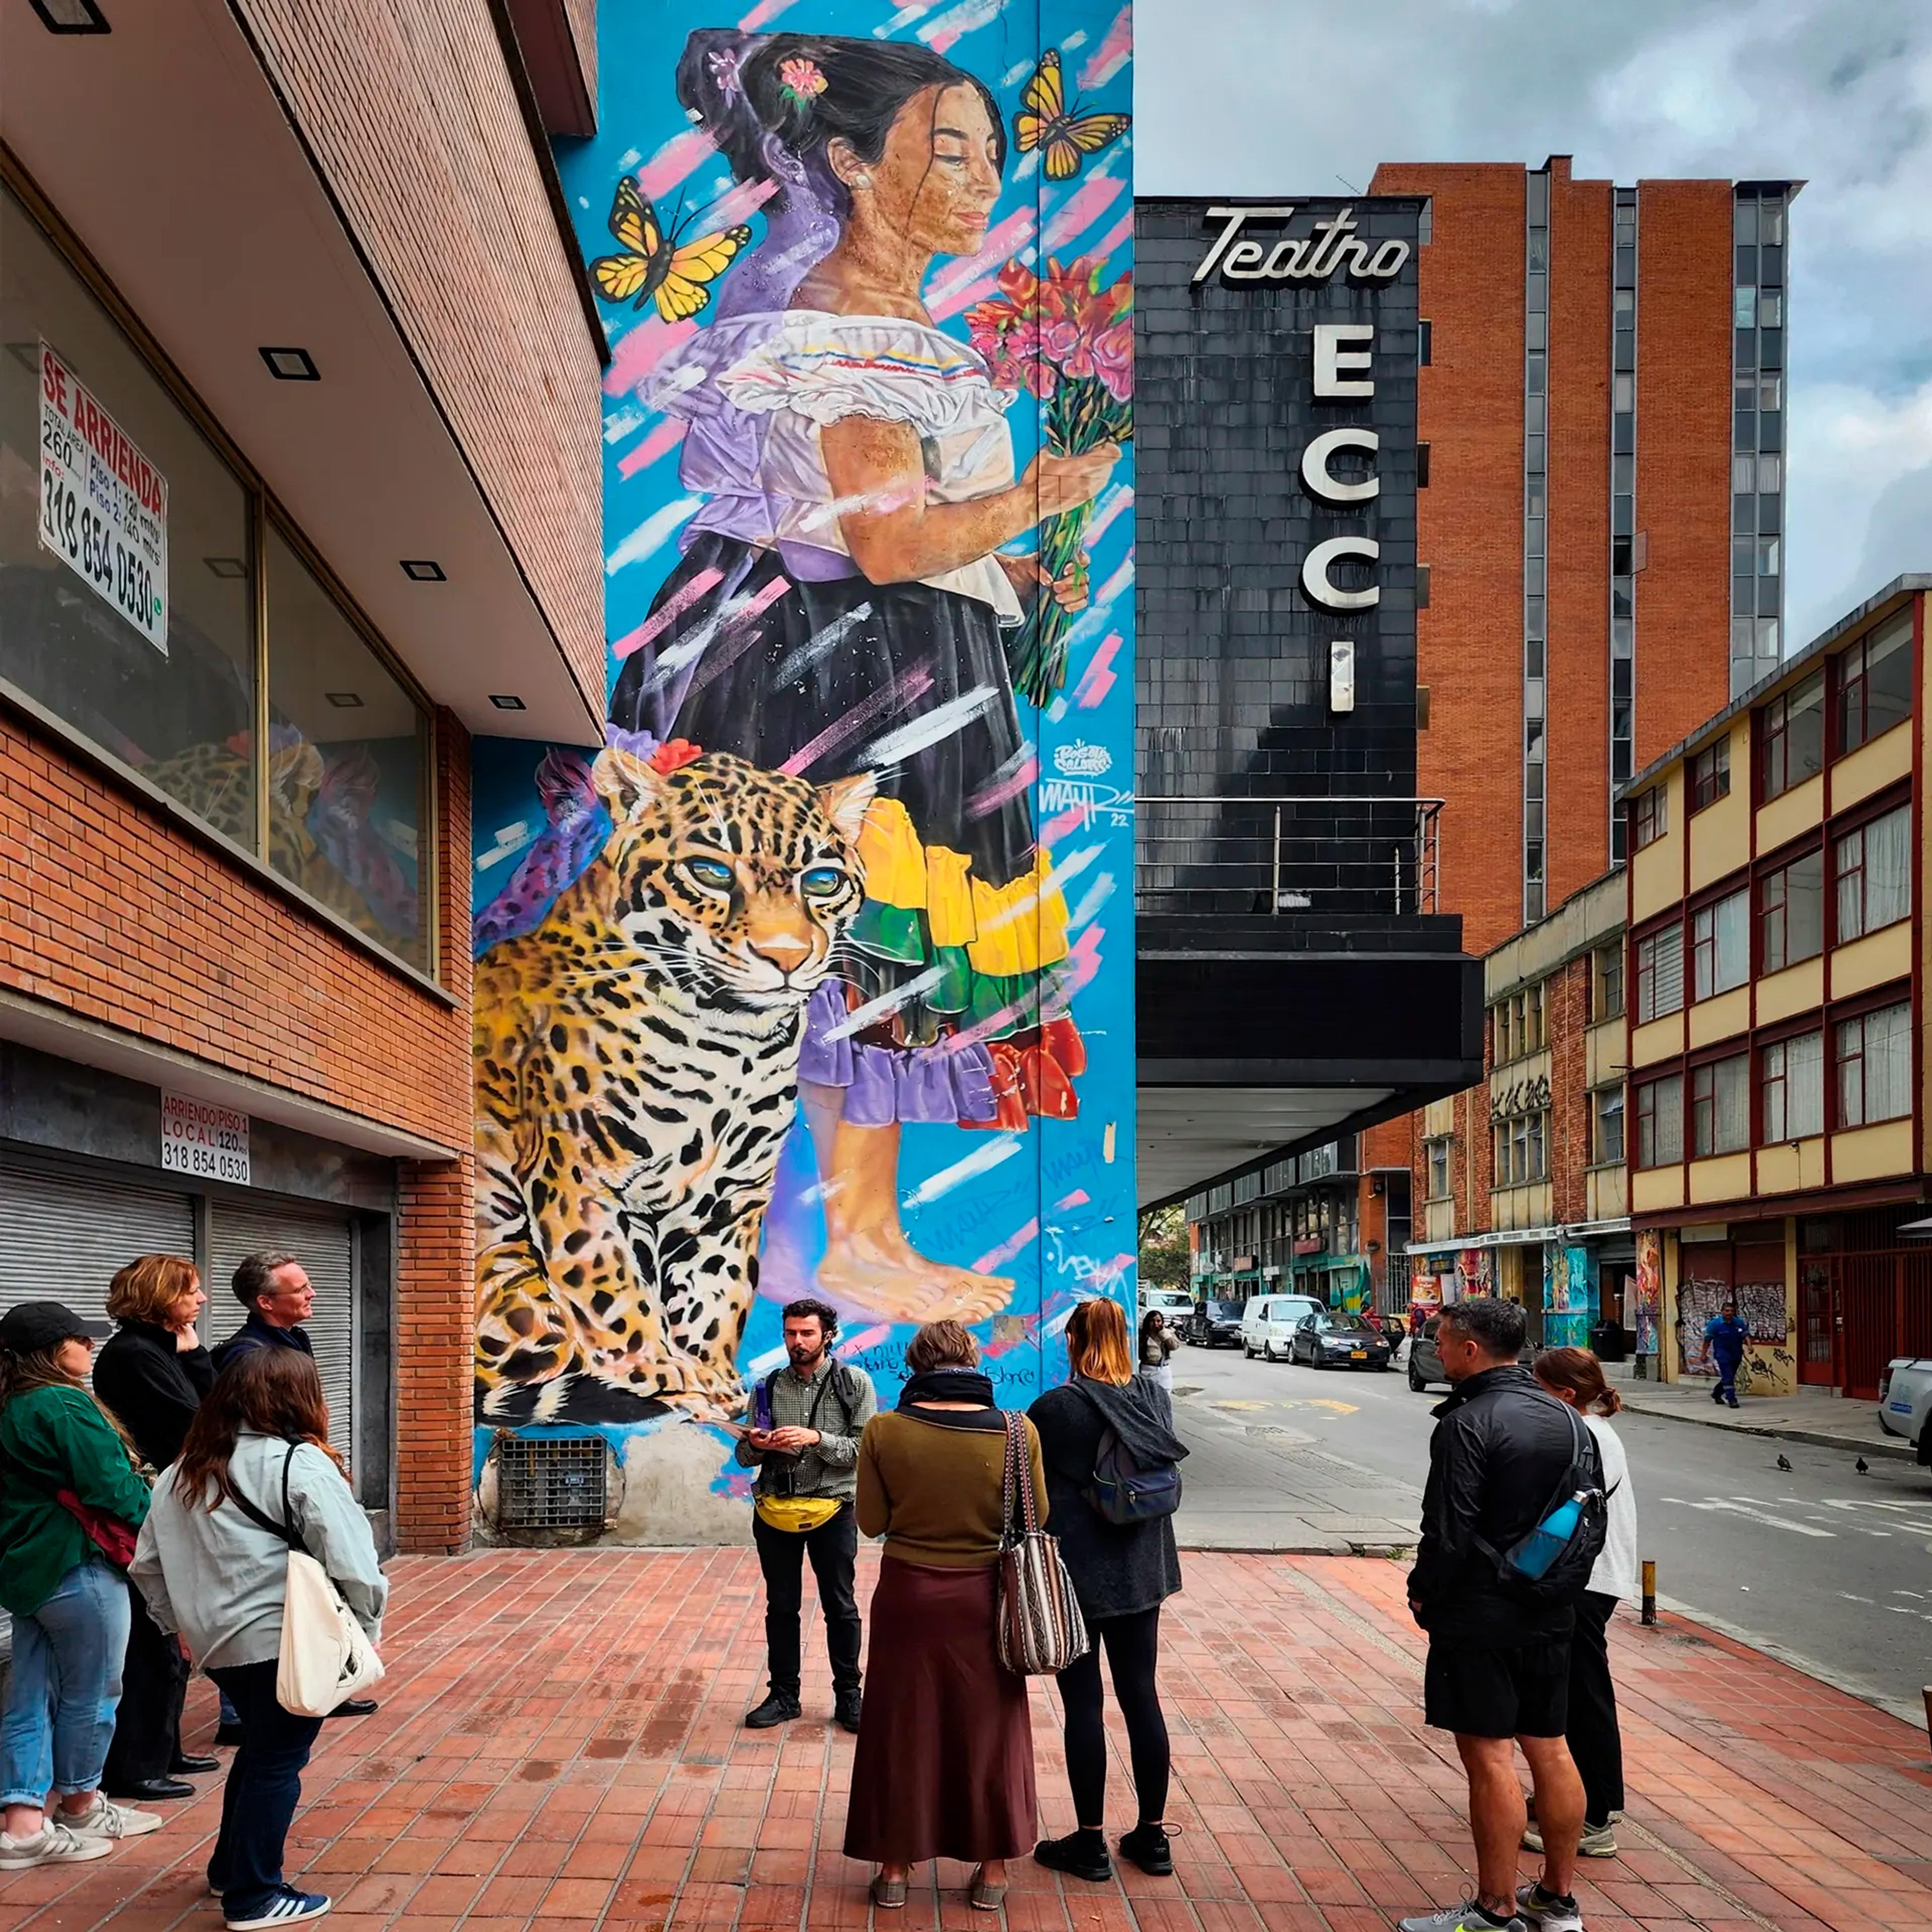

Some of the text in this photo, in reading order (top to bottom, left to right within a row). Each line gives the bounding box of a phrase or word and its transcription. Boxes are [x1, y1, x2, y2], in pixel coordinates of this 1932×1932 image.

[1191, 206, 1411, 282] Teatro
[43, 420, 71, 468] 260
[44, 351, 162, 524] SE ARRIENDA
[45, 404, 66, 436] TOTAL
[90, 478, 111, 514] Piso
[124, 515, 140, 544] 140
[91, 454, 110, 491] Piso
[124, 492, 138, 522] 120
[1302, 325, 1380, 711] ECCI
[43, 468, 153, 631] 318 854 0530
[1110, 813, 1130, 827] 22
[163, 1095, 248, 1135] ARRIENDO PISO 1
[163, 1117, 238, 1152] LOCAL 120
[164, 1142, 248, 1181] 318 854 0530
